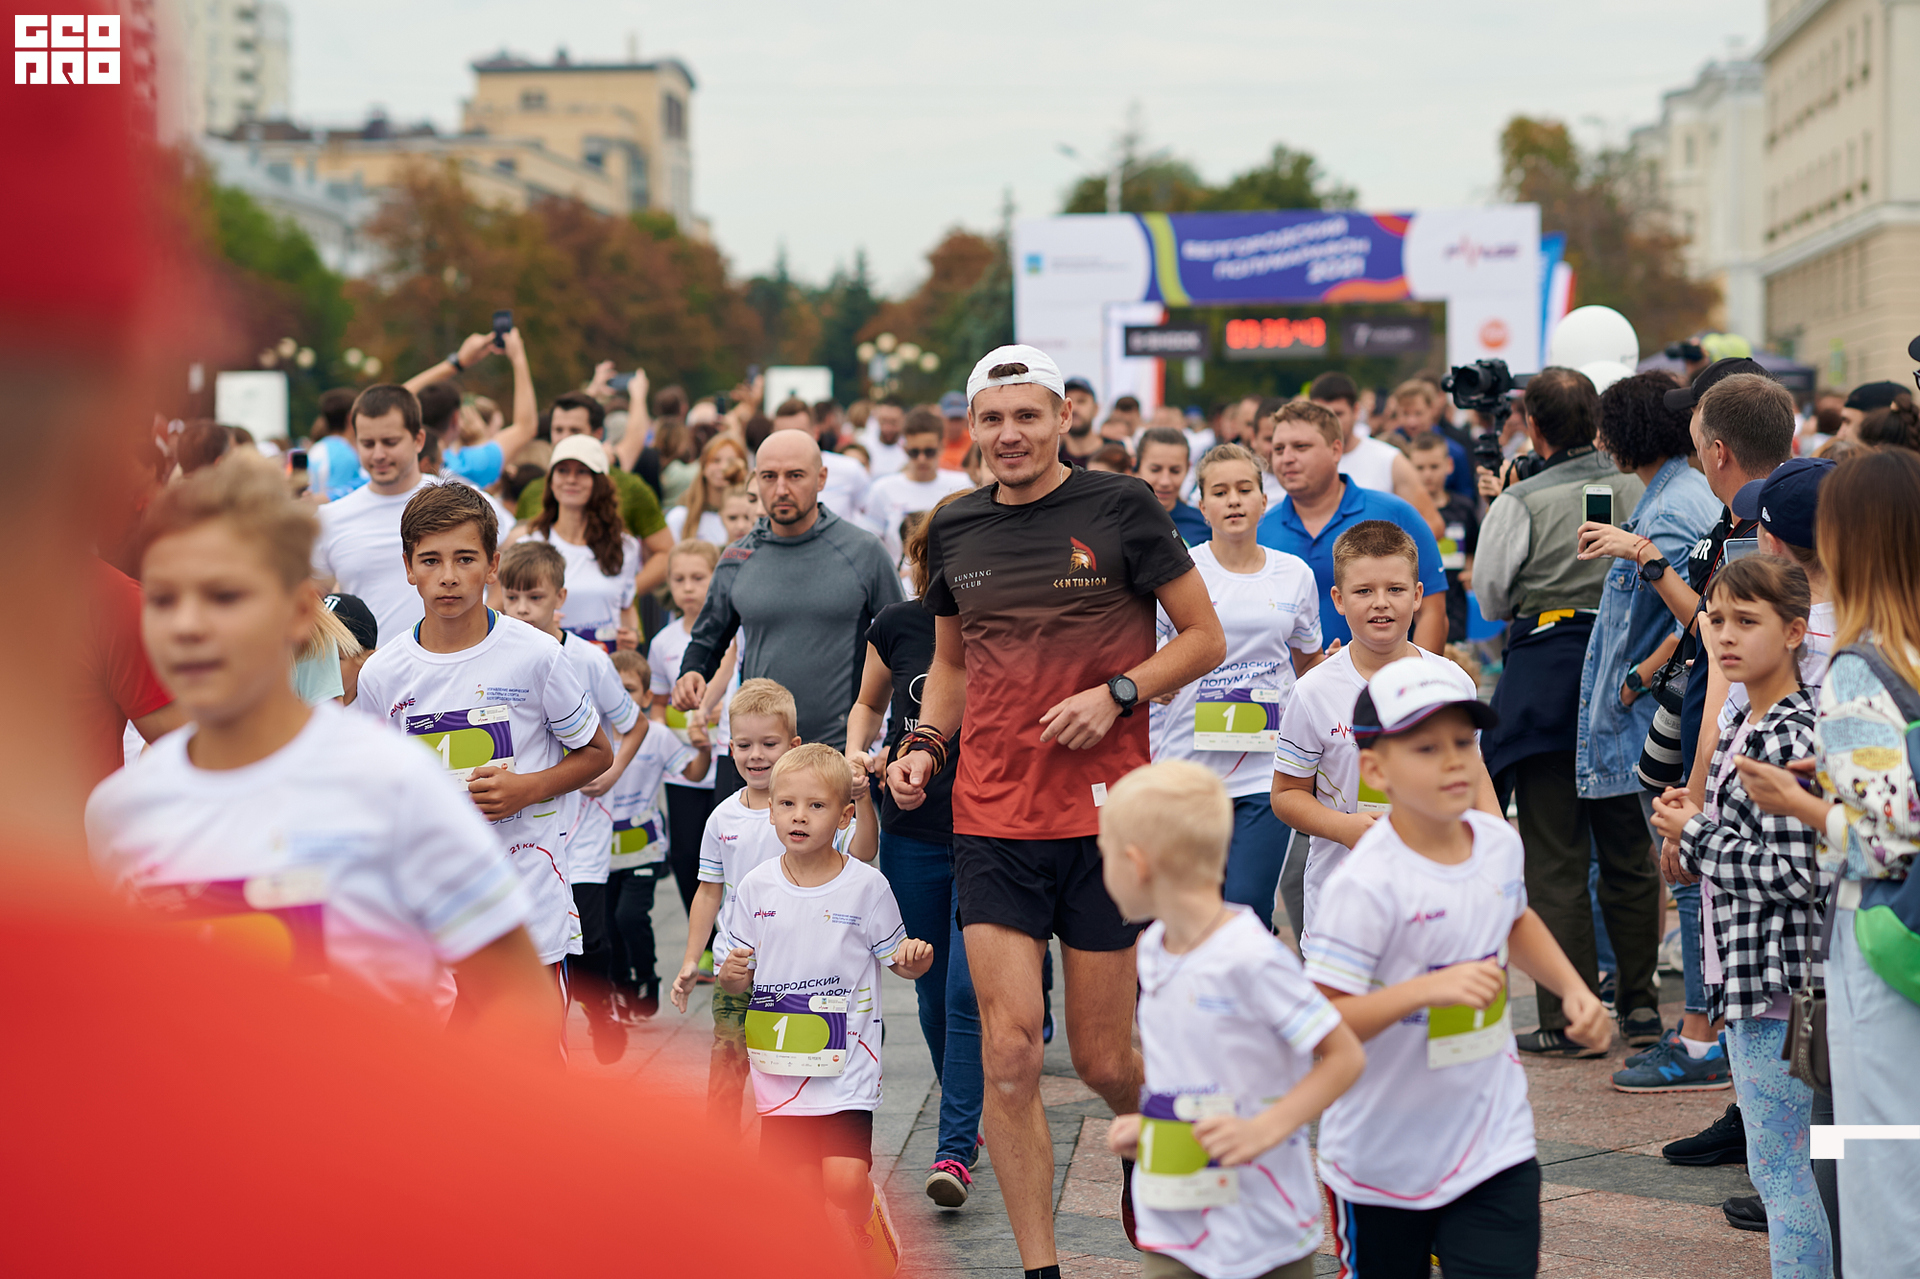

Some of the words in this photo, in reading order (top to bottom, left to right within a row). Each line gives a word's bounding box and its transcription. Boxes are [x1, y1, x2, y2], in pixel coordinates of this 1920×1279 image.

[954, 569, 992, 583] RUNNING
[960, 579, 982, 590] CLUB
[1052, 576, 1108, 590] CENTURION
[1222, 704, 1237, 732] 1
[436, 733, 451, 771] 1
[509, 843, 520, 854] 21
[772, 1015, 789, 1050] 1
[1140, 1121, 1155, 1171] 1
